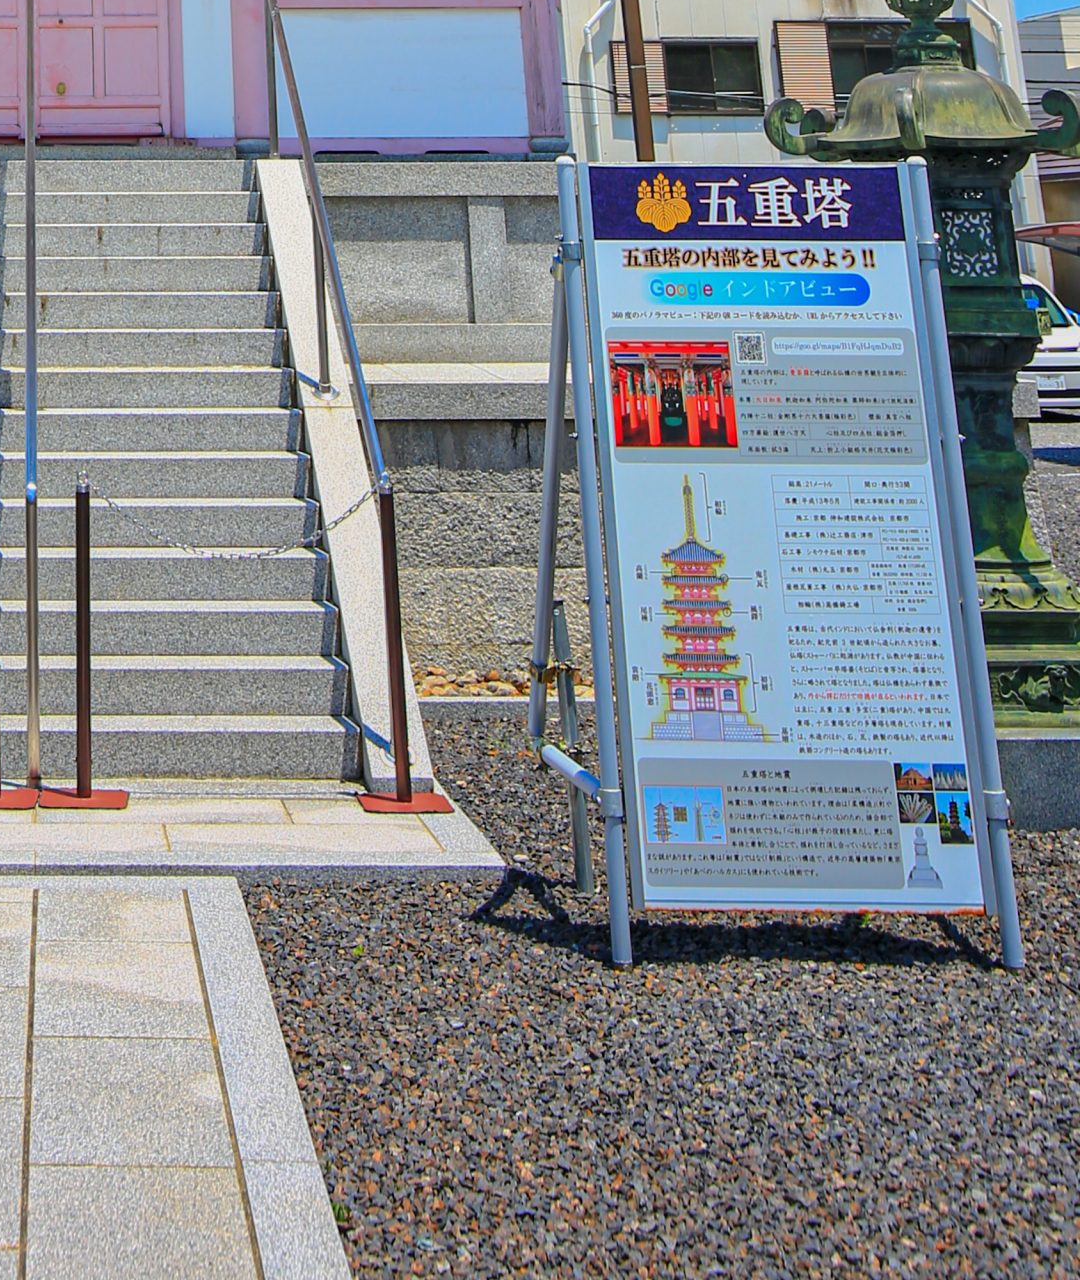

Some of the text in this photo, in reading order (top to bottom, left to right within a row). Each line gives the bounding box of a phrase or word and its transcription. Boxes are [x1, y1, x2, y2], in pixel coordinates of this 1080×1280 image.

[695, 176, 853, 229] 五重塔
[622, 248, 876, 269] 五重塔の内部を見てみよう!!
[650, 278, 857, 300] Google インドアビュー
